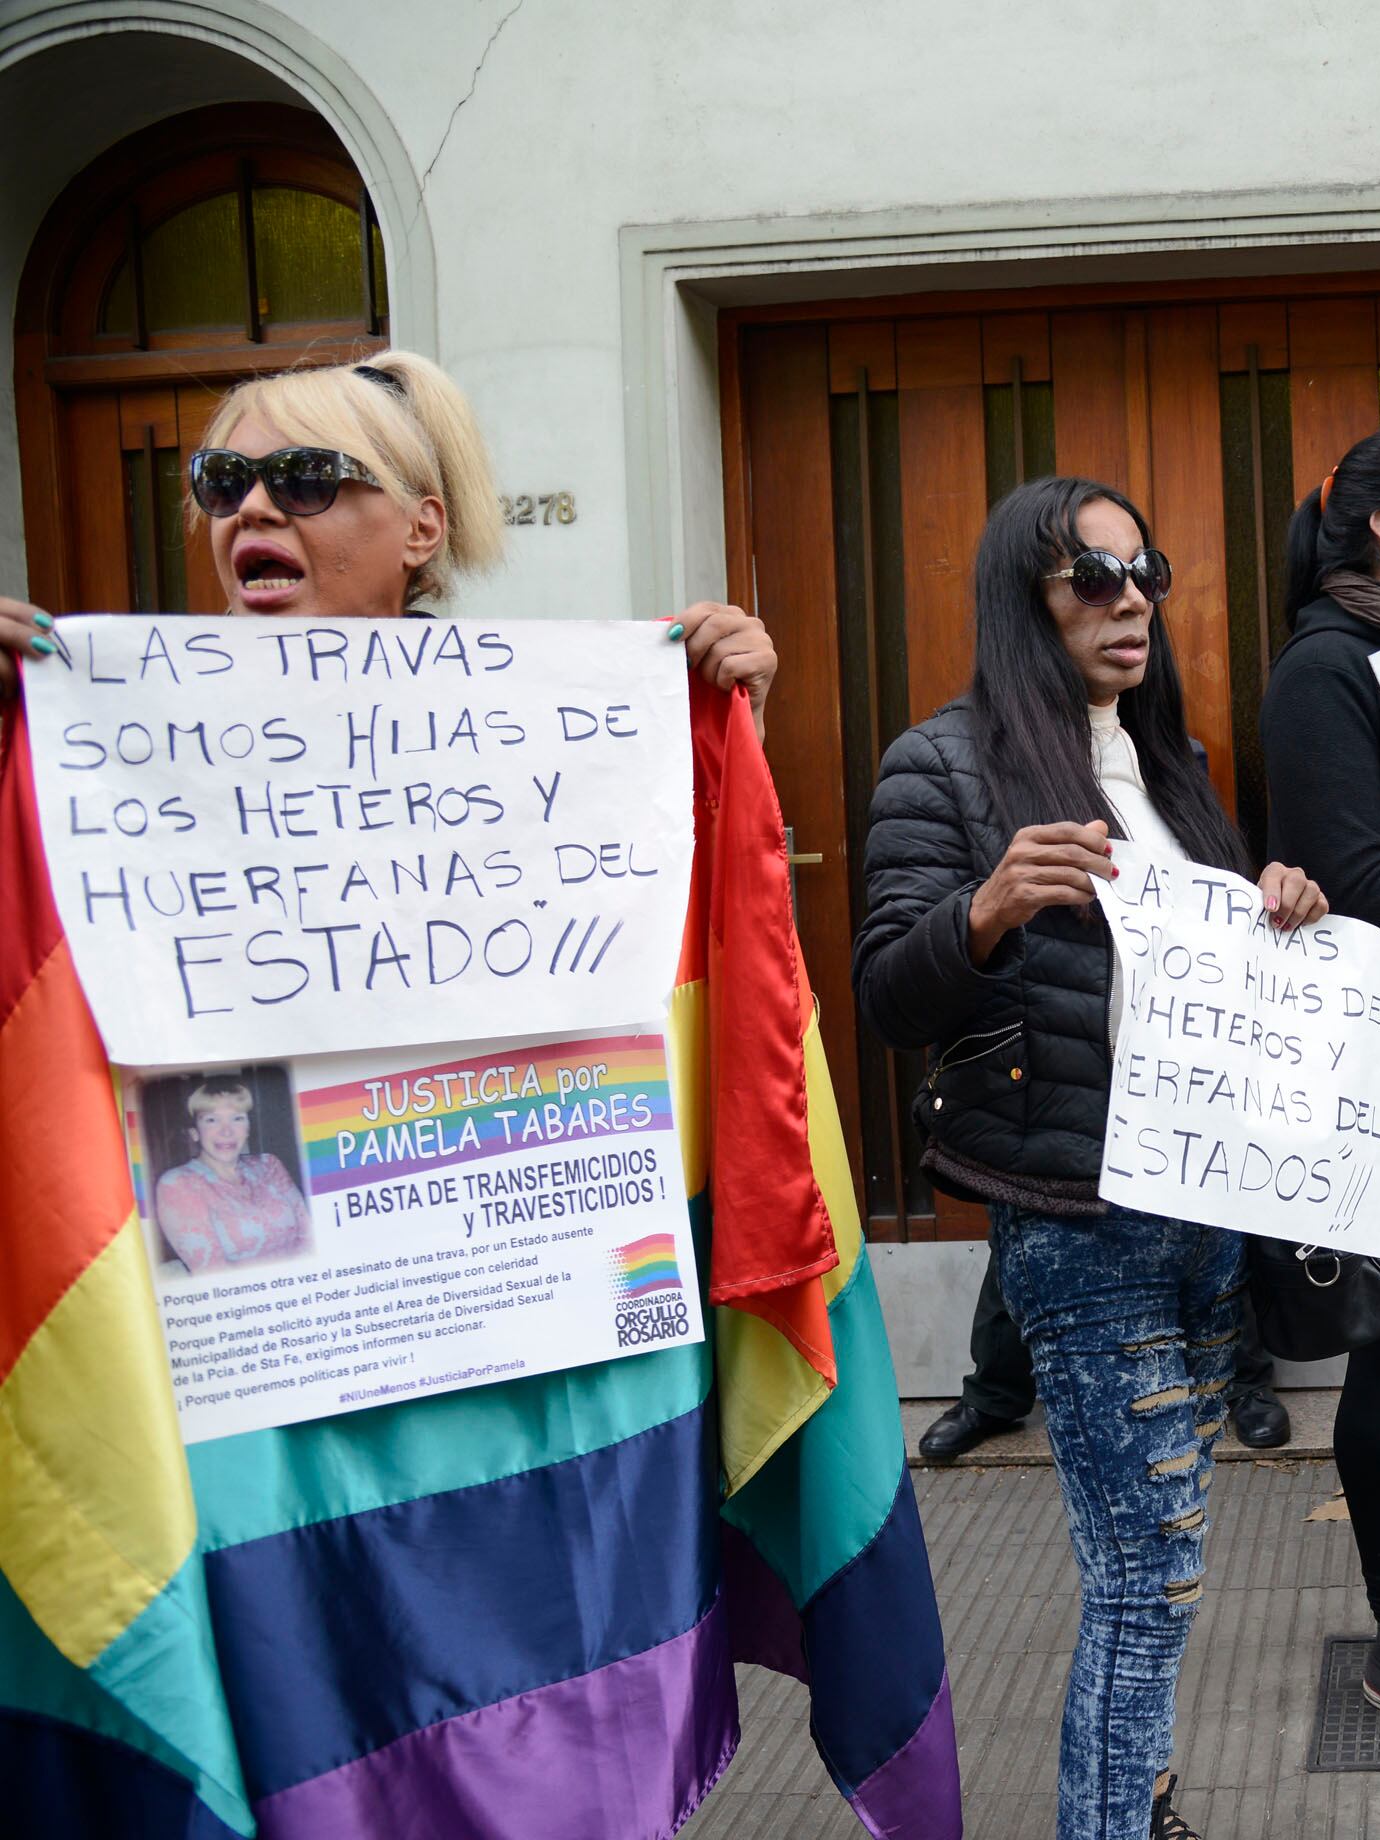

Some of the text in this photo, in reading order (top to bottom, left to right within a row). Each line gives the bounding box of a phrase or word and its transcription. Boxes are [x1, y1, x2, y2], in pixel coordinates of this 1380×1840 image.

[257, 624, 514, 683] TRAVAS
[59, 704, 639, 781] SOMOS HIJAS DE
[70, 771, 562, 838] LOS HETEROS Y
[80, 843, 659, 930] HUERFANAS DEL
[1147, 996, 1346, 1071] HETEROS Y
[361, 1063, 607, 1121] JUSTICIA por
[337, 1093, 653, 1169] PAMELA TABARES
[346, 1183, 423, 1219] BASTA
[428, 1177, 459, 1206] DE
[463, 1148, 657, 1200] TRANSFEMICIDIOS
[463, 1211, 475, 1238] y
[481, 1178, 655, 1228] TRAVESTICIDIOS
[163, 1291, 210, 1308] Porque
[213, 1280, 267, 1298] lloramos
[270, 1277, 295, 1289] otra
[298, 1272, 319, 1285] vez
[321, 1268, 333, 1281] el
[335, 1259, 392, 1279] asesinato
[395, 1256, 409, 1269] de
[412, 1253, 434, 1265] una
[471, 1245, 490, 1258] por
[493, 1241, 507, 1251] un
[510, 1234, 549, 1249] Estado
[551, 1226, 594, 1242] ausente
[166, 1255, 539, 1329] Porque exigimos que el Poder Judicial investigue con celeridad
[169, 1336, 216, 1353] Porque
[219, 1325, 265, 1344] Pamela
[267, 1317, 313, 1335] solicitó
[315, 1311, 352, 1327] ayuda
[355, 1305, 380, 1319] ante
[383, 1301, 394, 1313] el
[426, 1293, 440, 1306] de
[443, 1284, 503, 1303] Diversidad
[506, 1276, 543, 1292] Sexual
[546, 1272, 559, 1284] de
[562, 1270, 572, 1281] la
[171, 1289, 554, 1370] Municipalidad de Rosario y la Subsecretaría de Diversidad Sexual
[615, 1302, 688, 1330] ORGULLO
[616, 1292, 683, 1312] COORDINADORA
[617, 1318, 690, 1347] ROSARIO
[173, 1375, 190, 1388] de
[193, 1369, 205, 1382] la
[208, 1365, 239, 1381] Pcia.
[242, 1361, 257, 1373] de
[260, 1357, 281, 1370] Sta
[305, 1342, 360, 1362] exigimos
[362, 1332, 415, 1351] informen
[417, 1329, 432, 1340] su
[434, 1320, 486, 1337] accionar.
[185, 1390, 231, 1408] Porque
[234, 1378, 296, 1399] queremos
[299, 1367, 350, 1387] políticas
[353, 1362, 380, 1377] para
[382, 1355, 408, 1369] vivir
[419, 1359, 526, 1387] #JusticiaPorPamela
